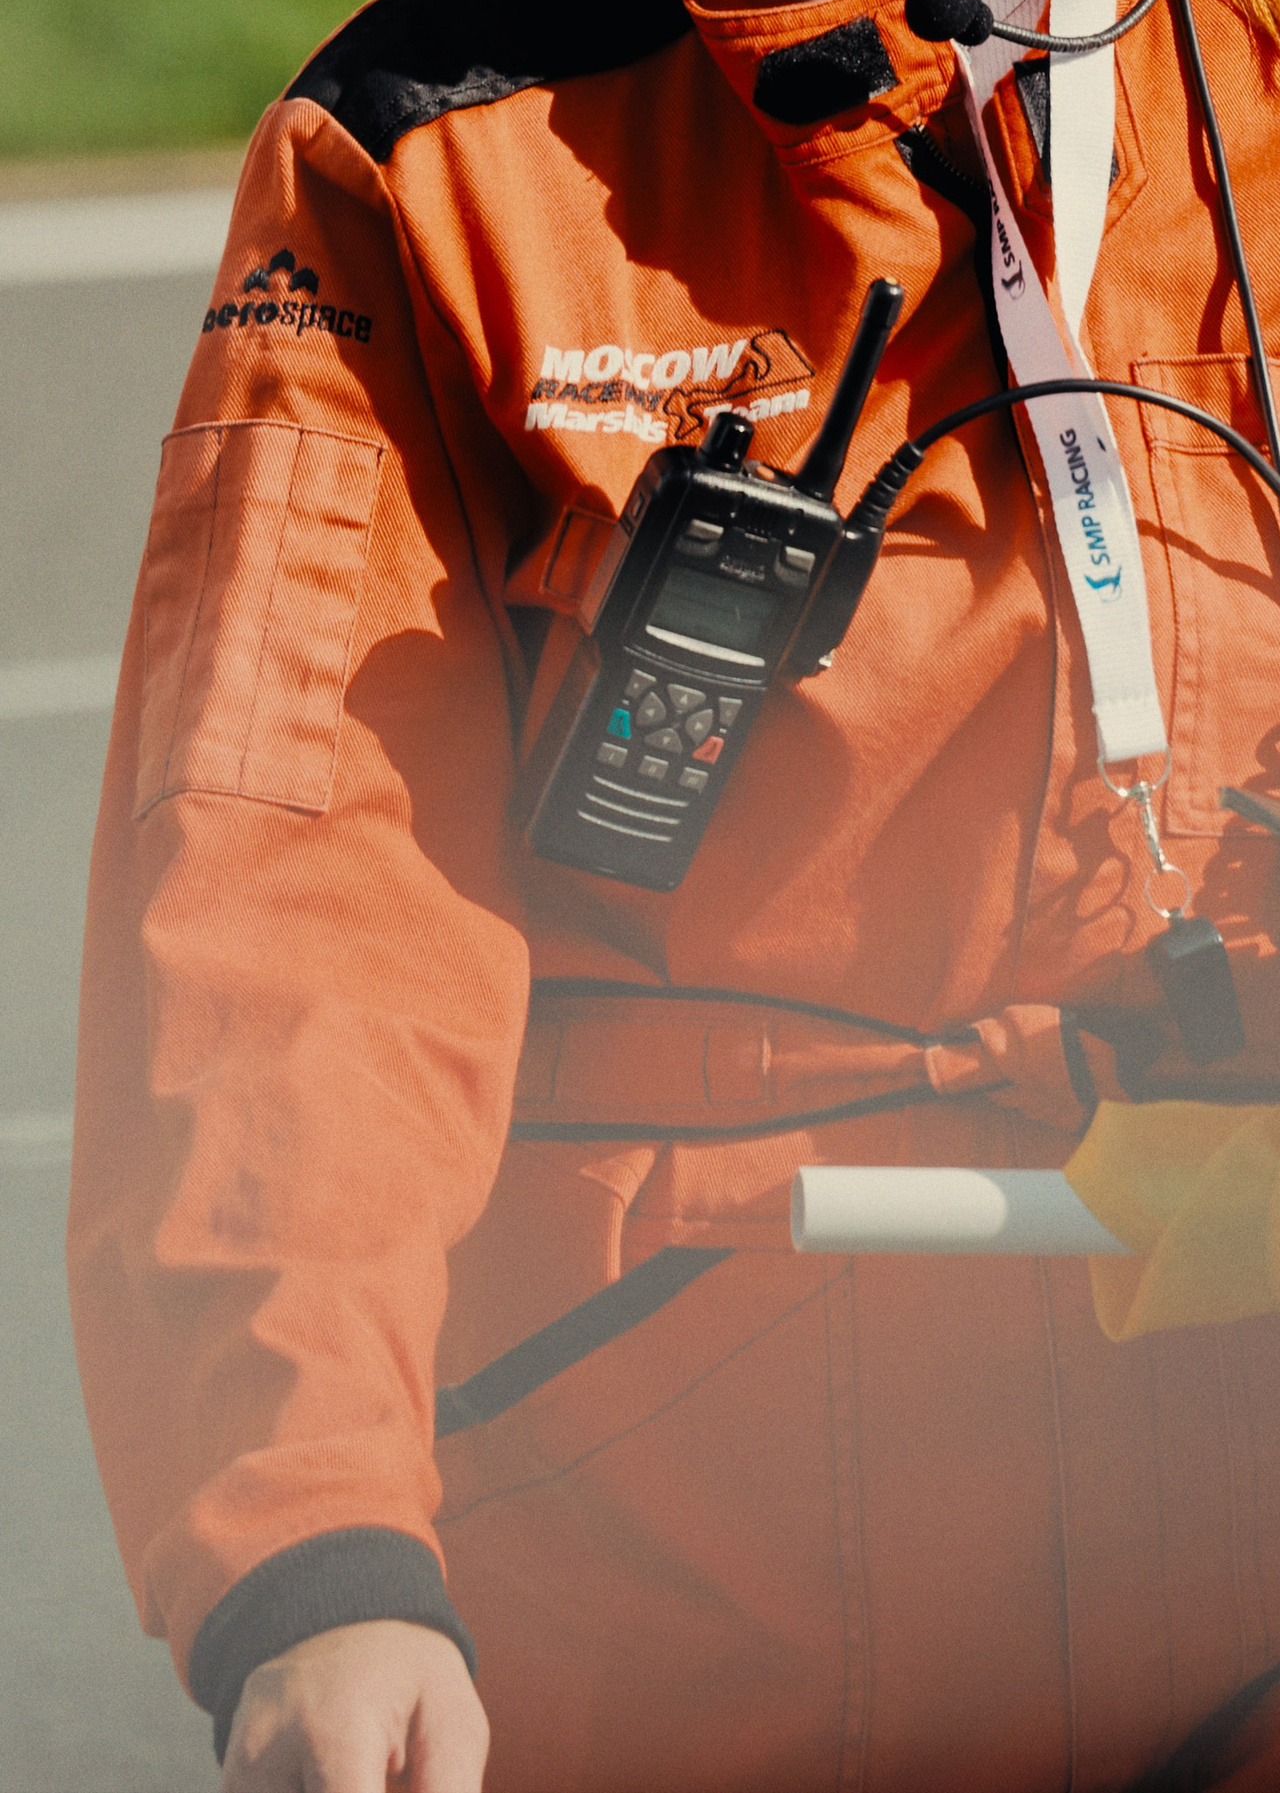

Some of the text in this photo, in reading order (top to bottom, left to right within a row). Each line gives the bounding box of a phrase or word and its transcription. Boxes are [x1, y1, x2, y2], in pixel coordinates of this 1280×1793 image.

[997, 219, 1016, 268] SMP
[202, 300, 373, 344] aerospace
[1060, 428, 1110, 565] SMP RACING
